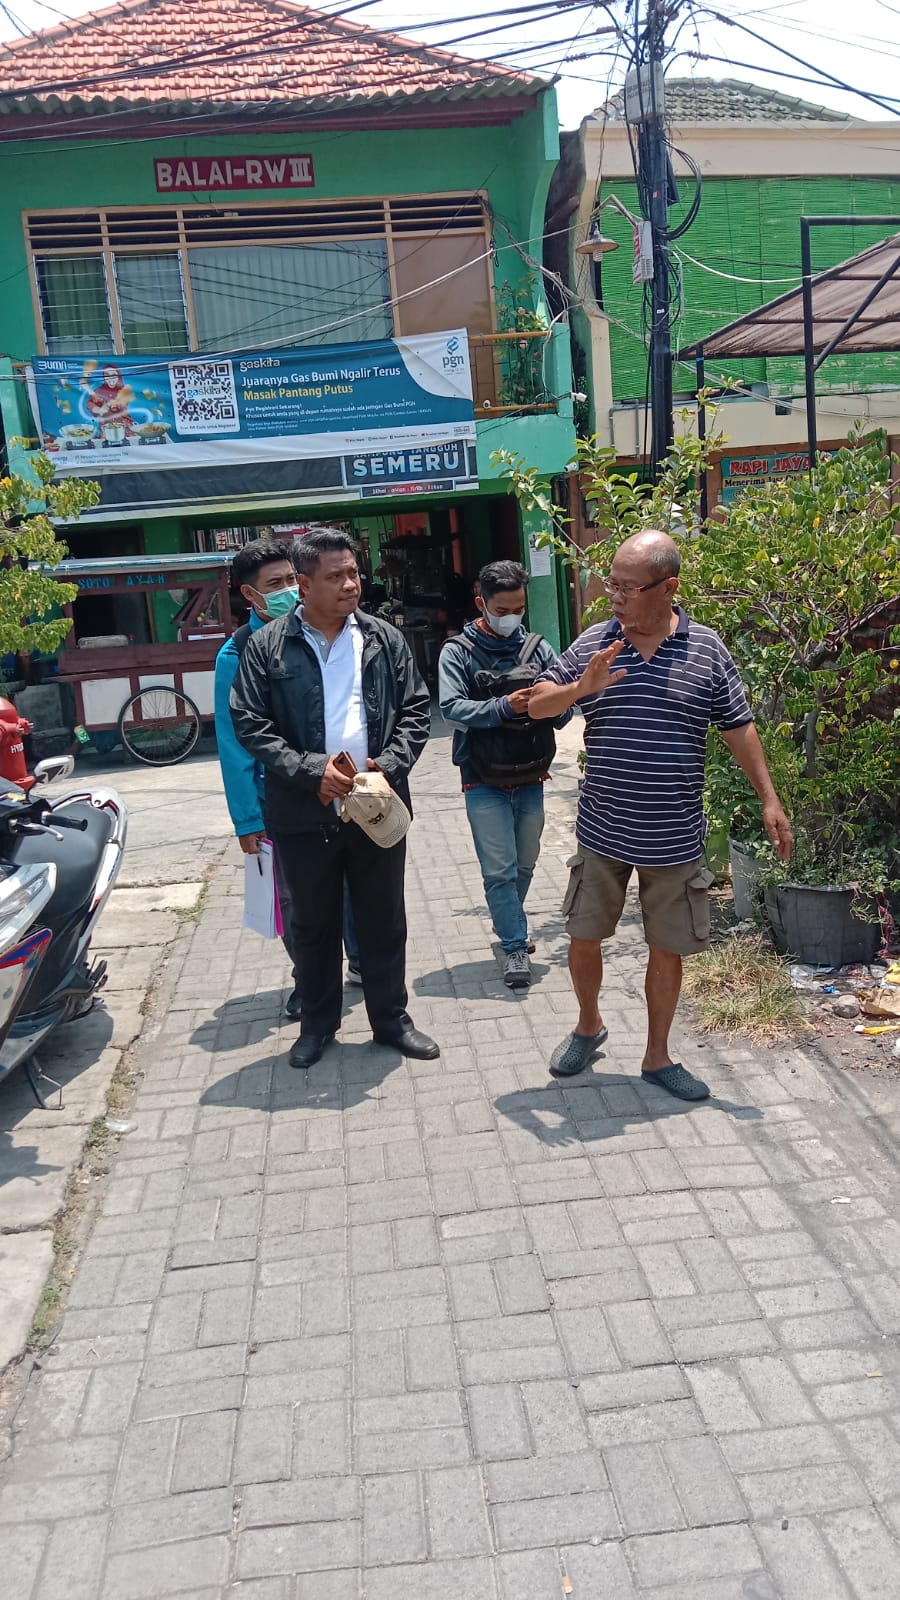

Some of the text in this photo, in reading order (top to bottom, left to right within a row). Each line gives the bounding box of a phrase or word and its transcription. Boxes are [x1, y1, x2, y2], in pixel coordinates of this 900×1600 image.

[239, 357, 281, 372] gaskita
[442, 355, 464, 369] pgn
[242, 366, 401, 388] Juaranya Gas Bumi Ngalir Terus
[244, 384, 354, 400] Masak Pantang Putus
[353, 452, 459, 476] SEMERU
[730, 458, 768, 475] RAPI
[725, 478, 766, 488] Menerima
[78, 575, 164, 589] SOTO AYAH
